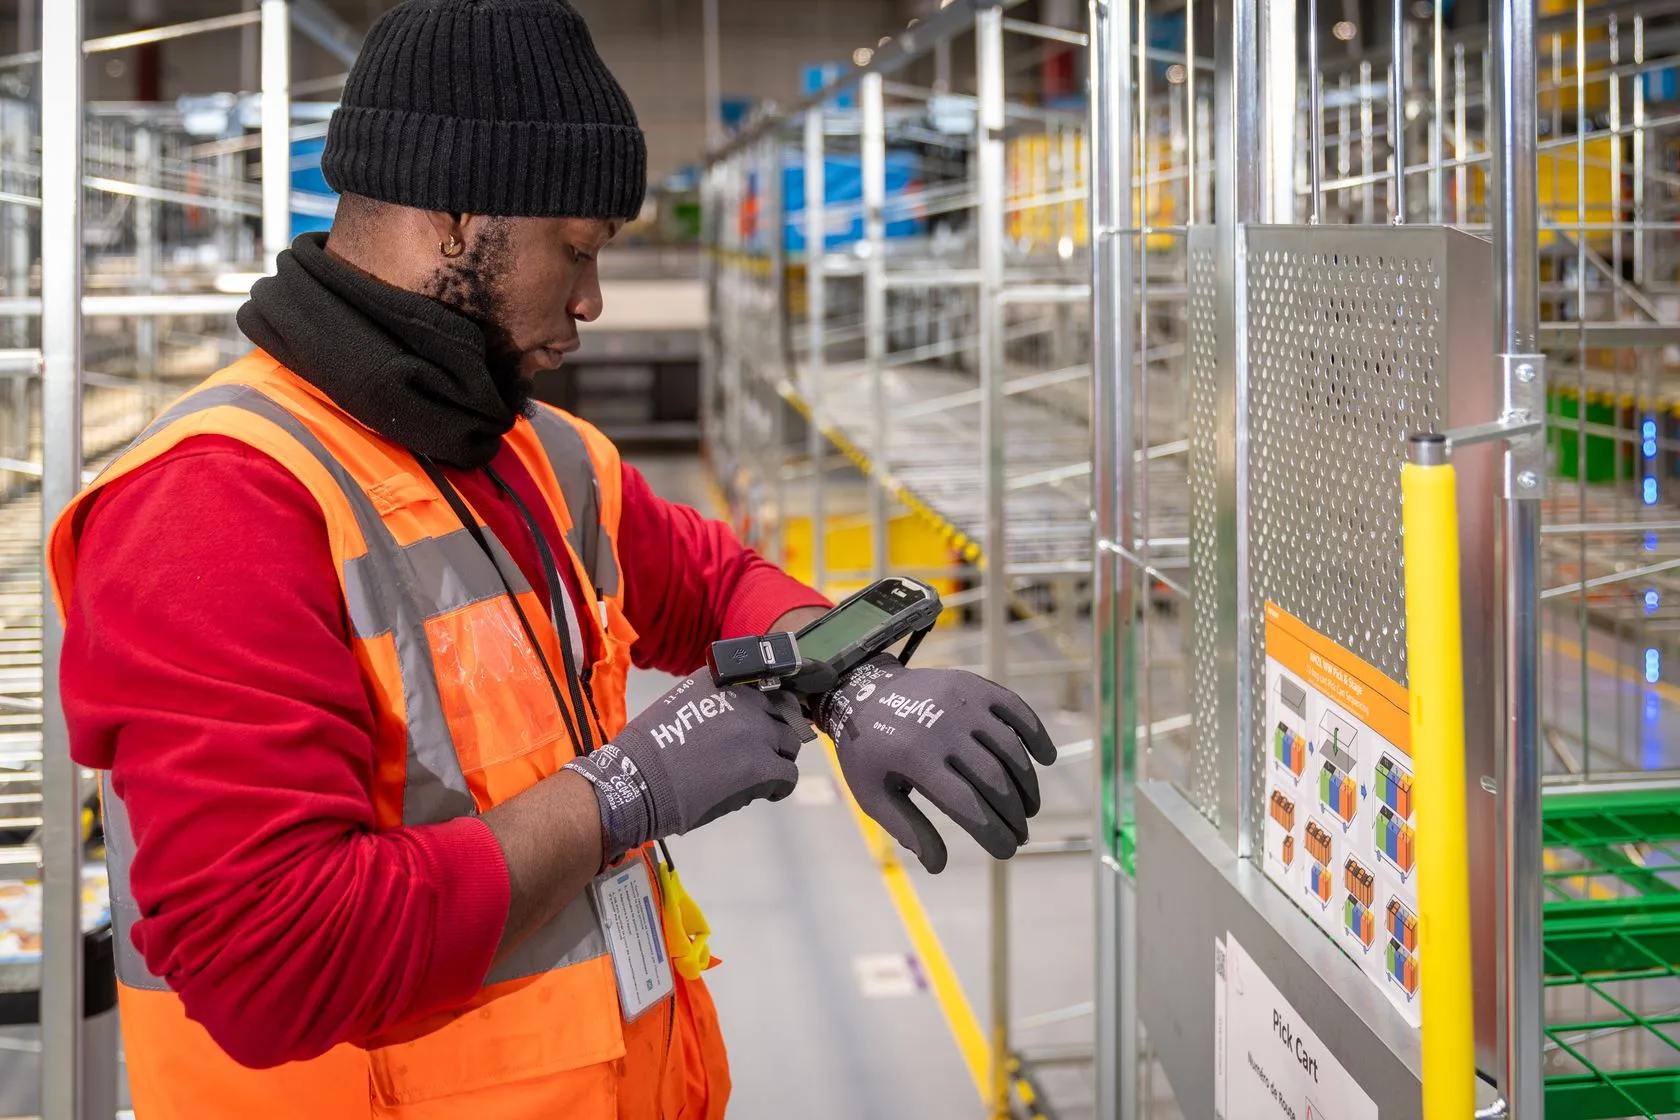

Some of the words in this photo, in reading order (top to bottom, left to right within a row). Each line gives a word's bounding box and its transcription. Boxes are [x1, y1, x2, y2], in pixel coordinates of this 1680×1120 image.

[663, 679, 695, 705] 11-840
[873, 721, 896, 736] 11-840
[1272, 1007, 1293, 1053] Pick
[1295, 1036, 1319, 1085] Cart
[1270, 1082, 1279, 1101] de
[1278, 1091, 1296, 1120] Route
